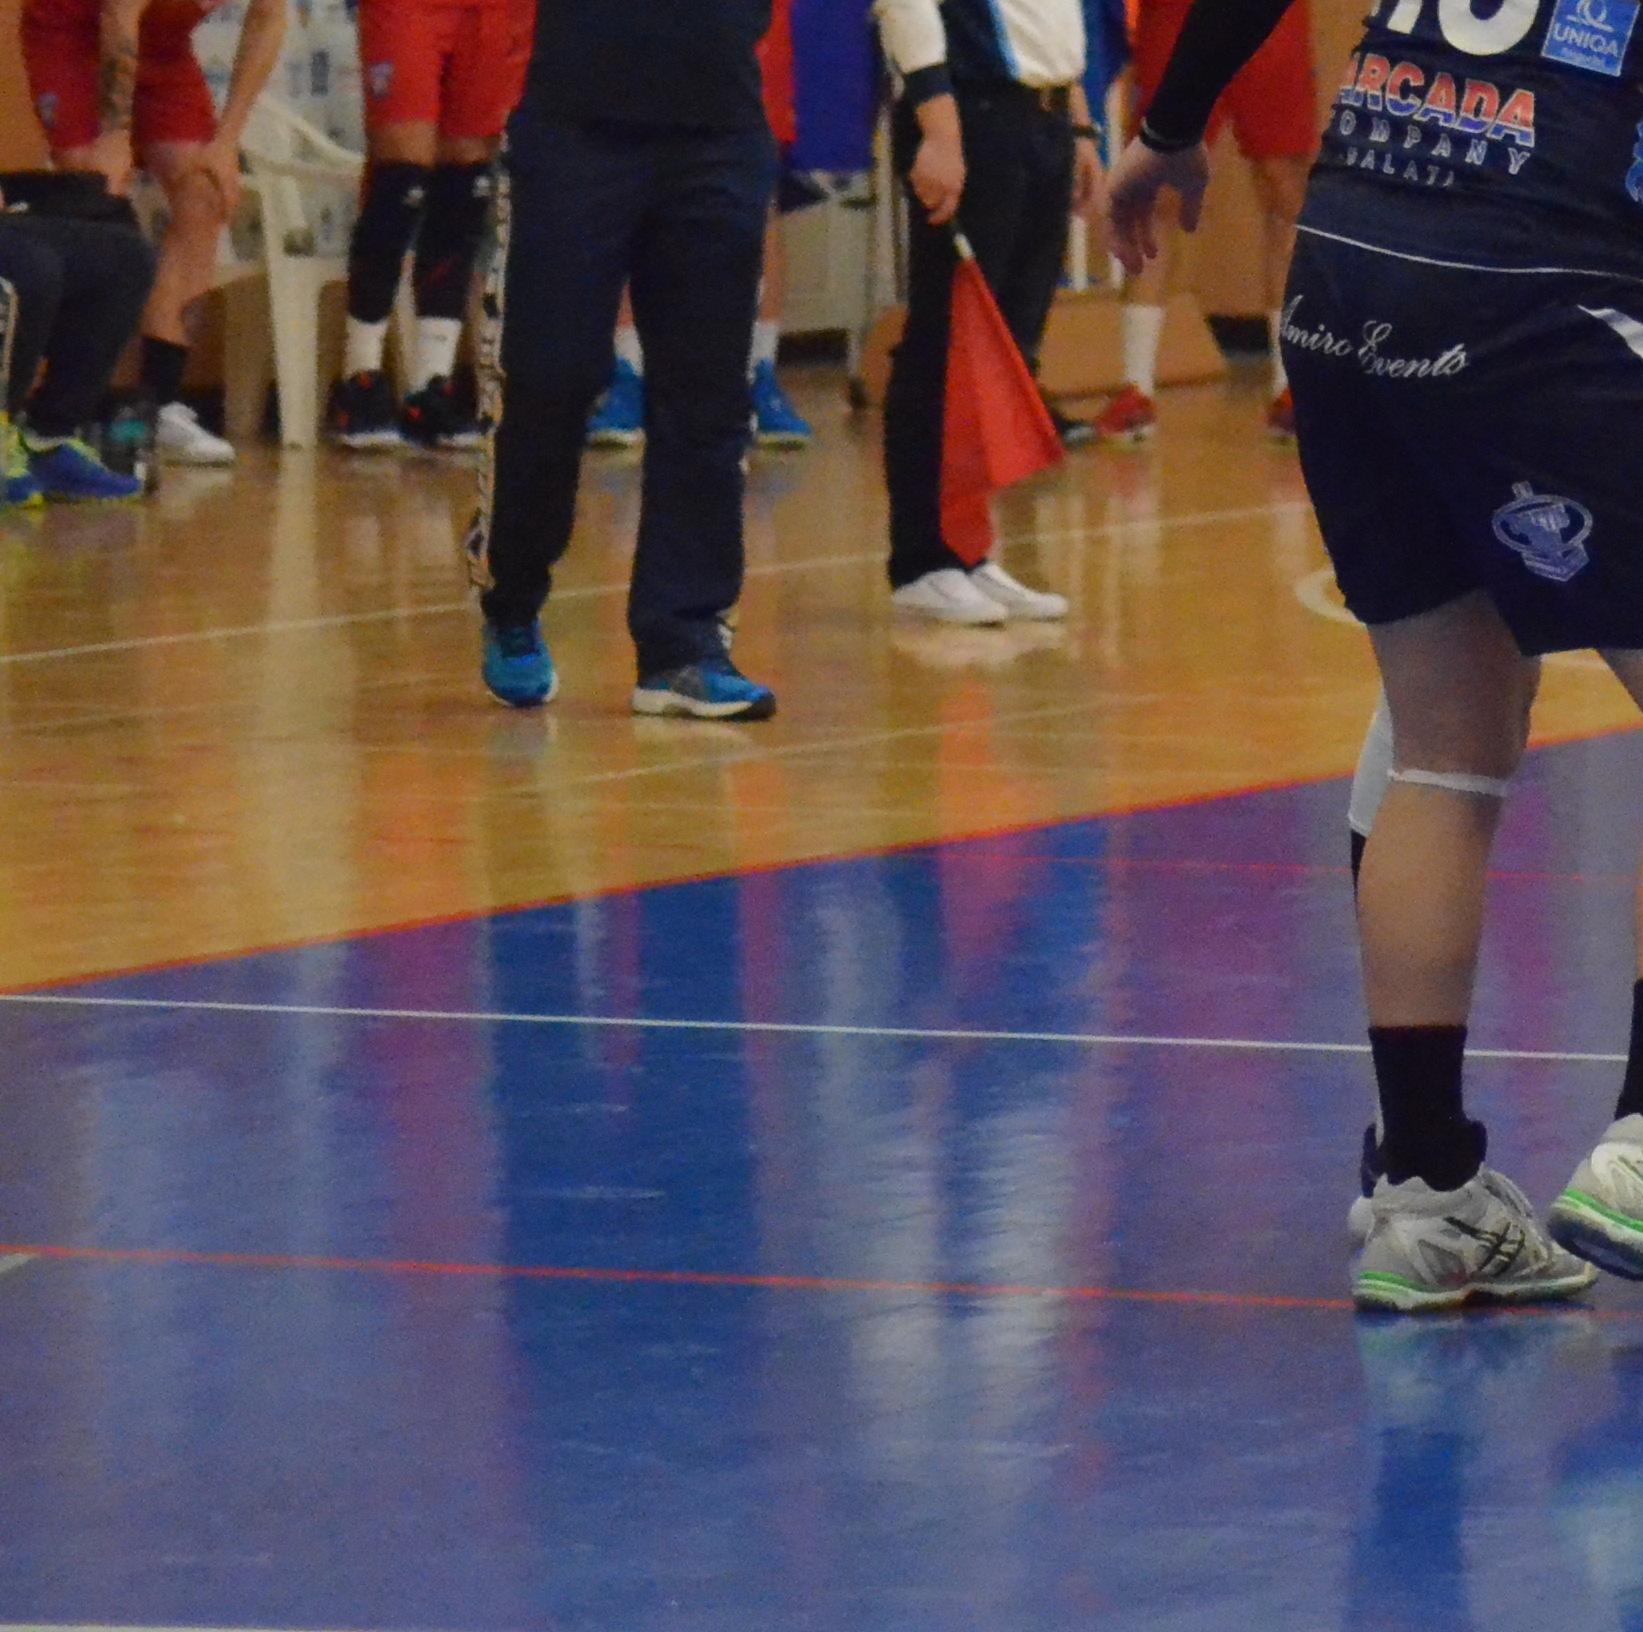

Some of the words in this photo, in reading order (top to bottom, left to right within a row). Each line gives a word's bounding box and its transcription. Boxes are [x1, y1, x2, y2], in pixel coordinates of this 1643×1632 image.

[1552, 22, 1620, 58] UNIQA
[1331, 109, 1531, 176] OMPANY
[1357, 320, 1468, 378] Events
